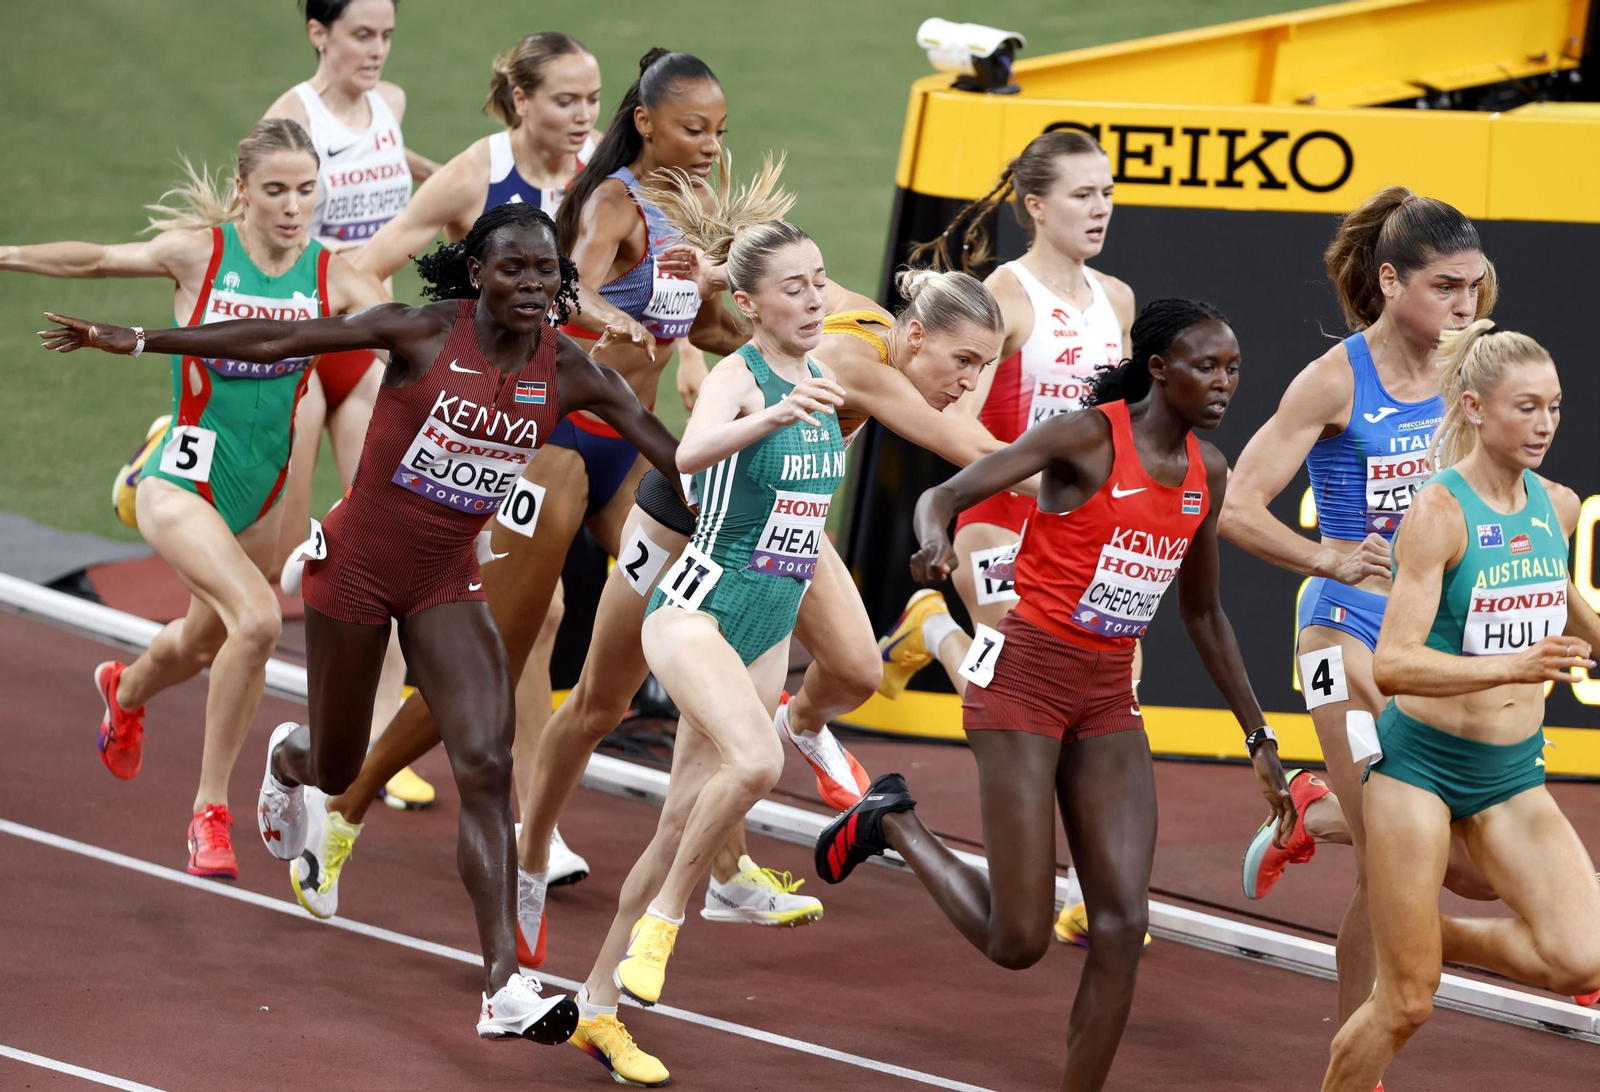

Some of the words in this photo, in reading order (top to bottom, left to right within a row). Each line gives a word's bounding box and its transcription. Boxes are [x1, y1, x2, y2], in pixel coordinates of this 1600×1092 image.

[329, 163, 406, 187] HONDA
[210, 299, 313, 321] HONDA
[1055, 347, 1083, 365] 4F
[430, 389, 538, 448] KENYA
[175, 434, 199, 470] 5
[422, 423, 527, 465] HONDA
[410, 447, 516, 493] EJORE
[502, 483, 536, 526] 10
[625, 540, 649, 582] 2
[1111, 526, 1189, 561] KENYA
[671, 555, 711, 601] 11
[1475, 556, 1566, 589] AUSTRALIA
[1472, 590, 1567, 613] HONDA
[1311, 658, 1334, 697] 4
